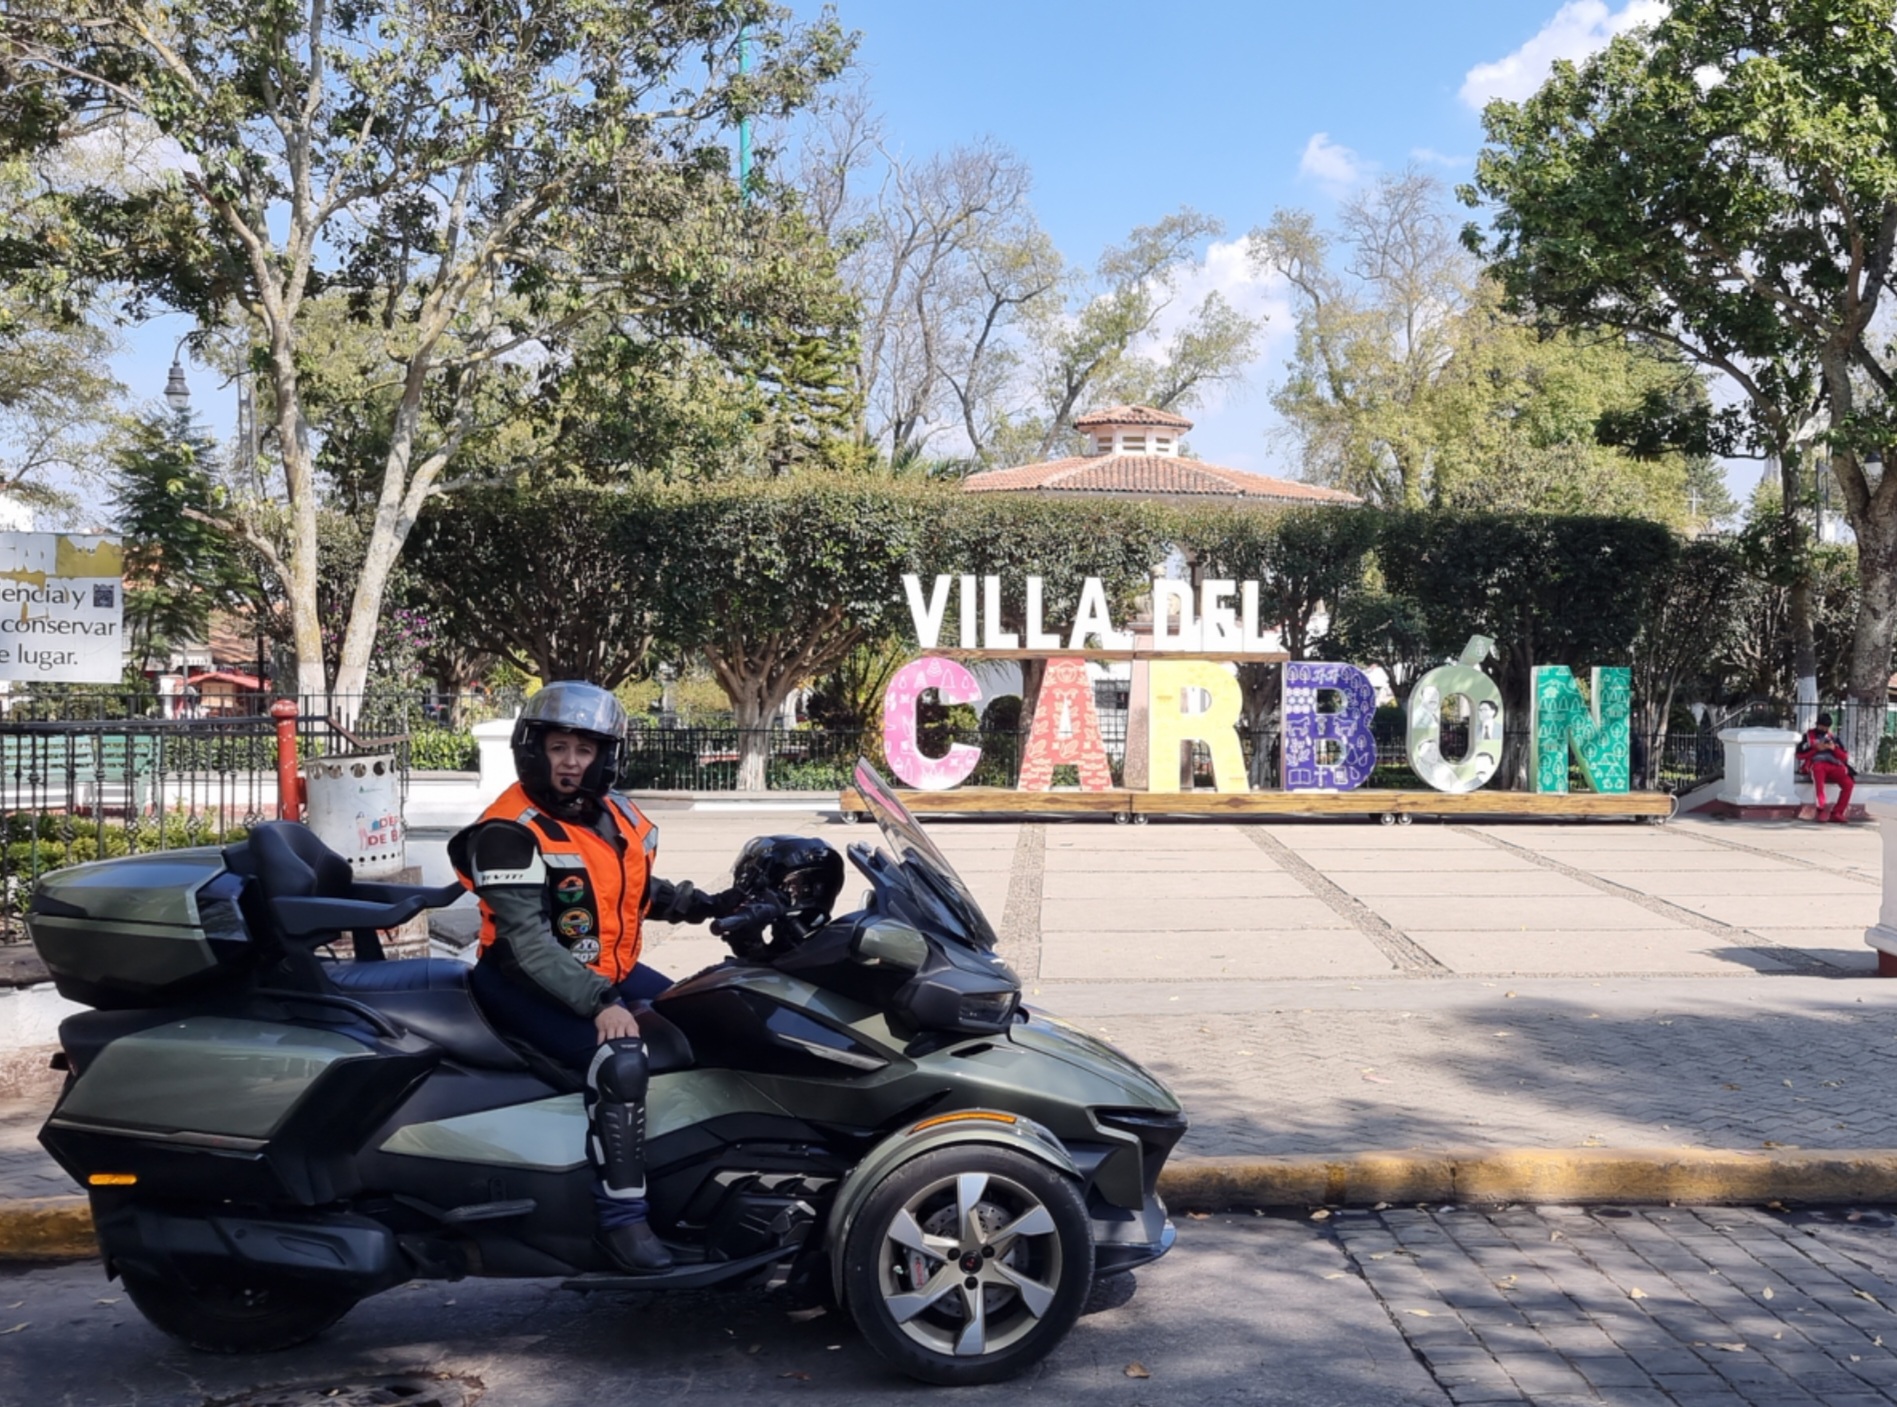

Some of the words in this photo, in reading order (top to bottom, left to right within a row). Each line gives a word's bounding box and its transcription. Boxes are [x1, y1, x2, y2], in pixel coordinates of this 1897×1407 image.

[72, 590, 86, 610] y
[901, 574, 1117, 650] VILLA
[1153, 578, 1278, 652] DEL
[1, 619, 116, 636] conservar
[17, 643, 78, 671] lugar.
[884, 634, 1631, 794] CARBÓN
[367, 833, 388, 847] DE
